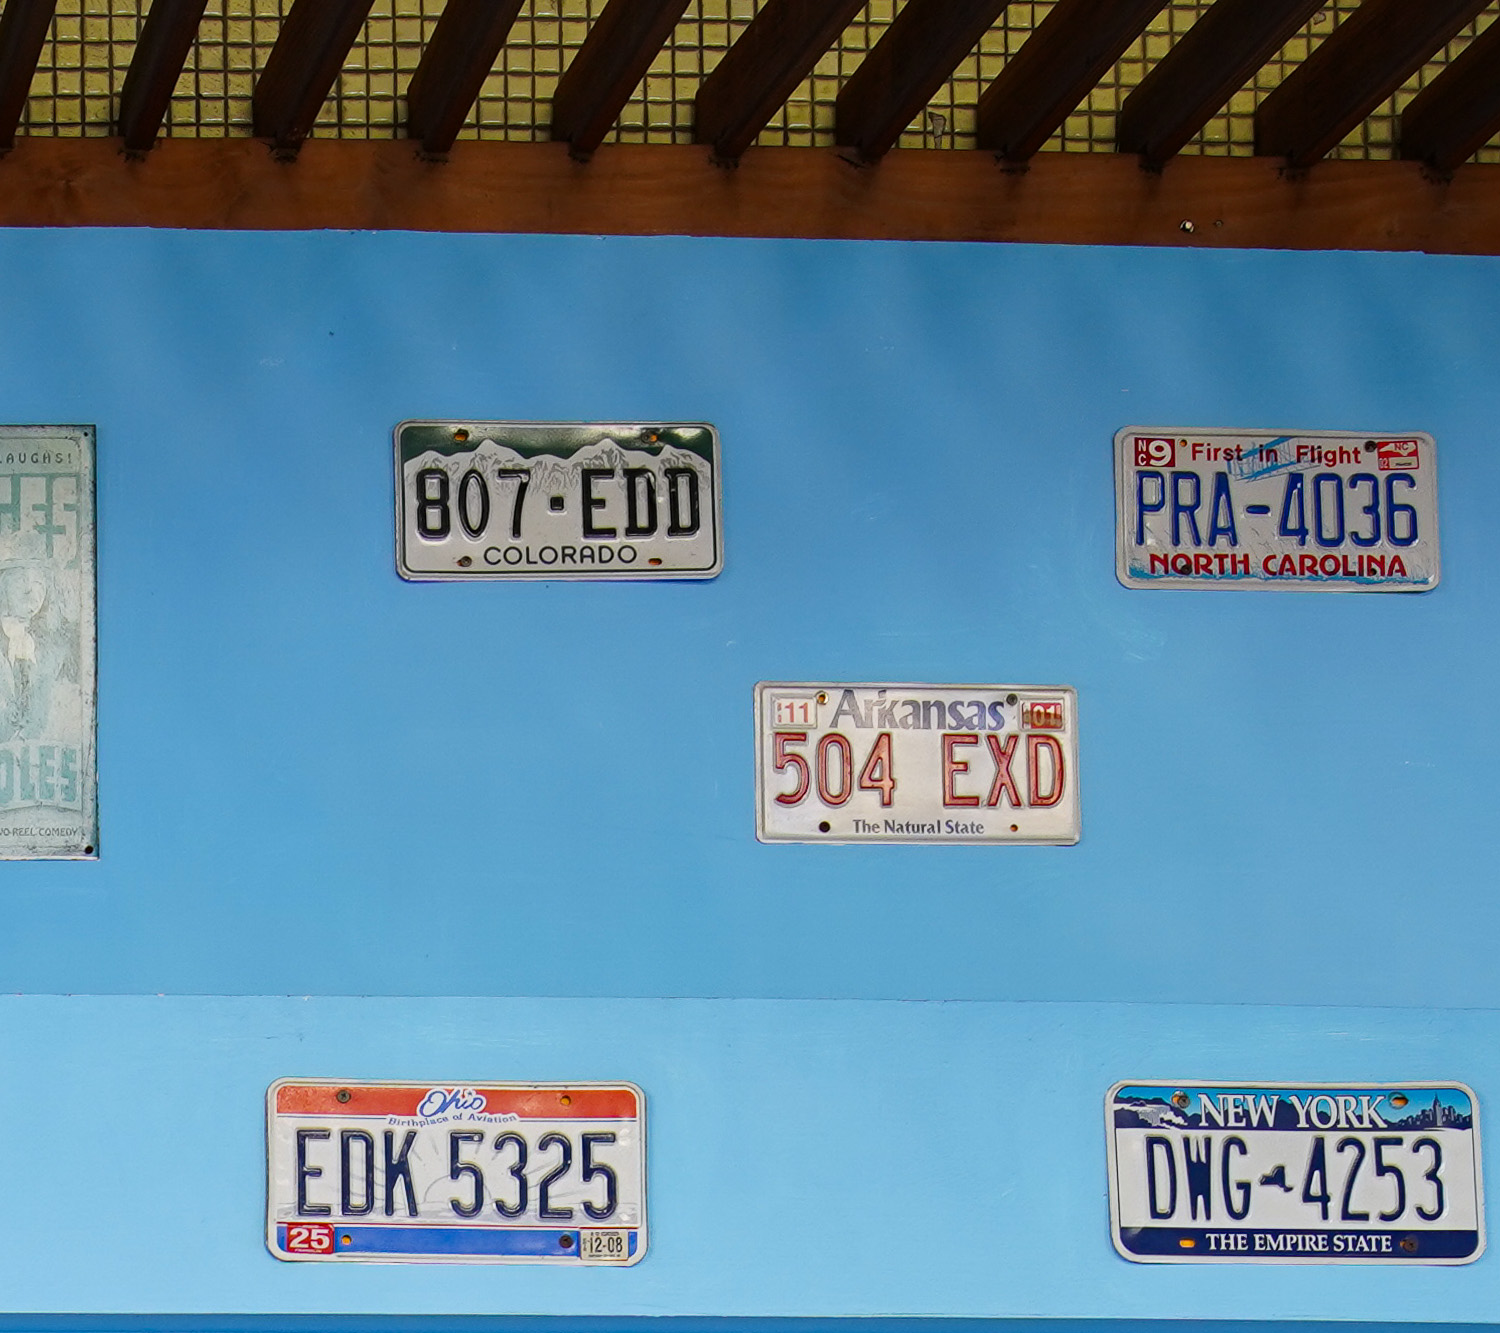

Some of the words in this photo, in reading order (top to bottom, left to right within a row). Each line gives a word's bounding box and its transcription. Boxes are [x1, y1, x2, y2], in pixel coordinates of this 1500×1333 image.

[1149, 440, 1174, 467] 9
[1191, 442, 1243, 463] First
[1258, 443, 1279, 462] in
[1295, 443, 1362, 467] Flight
[1135, 471, 1418, 549] PRA-4036
[482, 544, 637, 567] COLORADO
[1149, 552, 1251, 577] NORTH
[1262, 553, 1407, 578] CAROLINA
[829, 688, 1005, 731] Arkansas
[772, 732, 896, 808] 504
[941, 733, 1065, 809] EXD
[852, 818, 881, 835] The
[883, 818, 941, 835] Natural
[944, 818, 985, 835] State
[419, 1089, 486, 1117] Ohio
[1197, 1093, 1281, 1128] NEW
[1288, 1095, 1389, 1130] YORK
[388, 1114, 450, 1129] Birthplace
[452, 1112, 465, 1122] of
[467, 1112, 517, 1123] Aviation
[297, 1130, 419, 1217] EDK
[449, 1131, 618, 1220] 5325
[1145, 1134, 1252, 1221] DWG
[1301, 1135, 1446, 1223] 4253
[288, 1226, 331, 1250] 25
[1206, 1233, 1251, 1251] THE
[1253, 1234, 1330, 1252] EMPIRE
[1332, 1235, 1393, 1253] STATE
